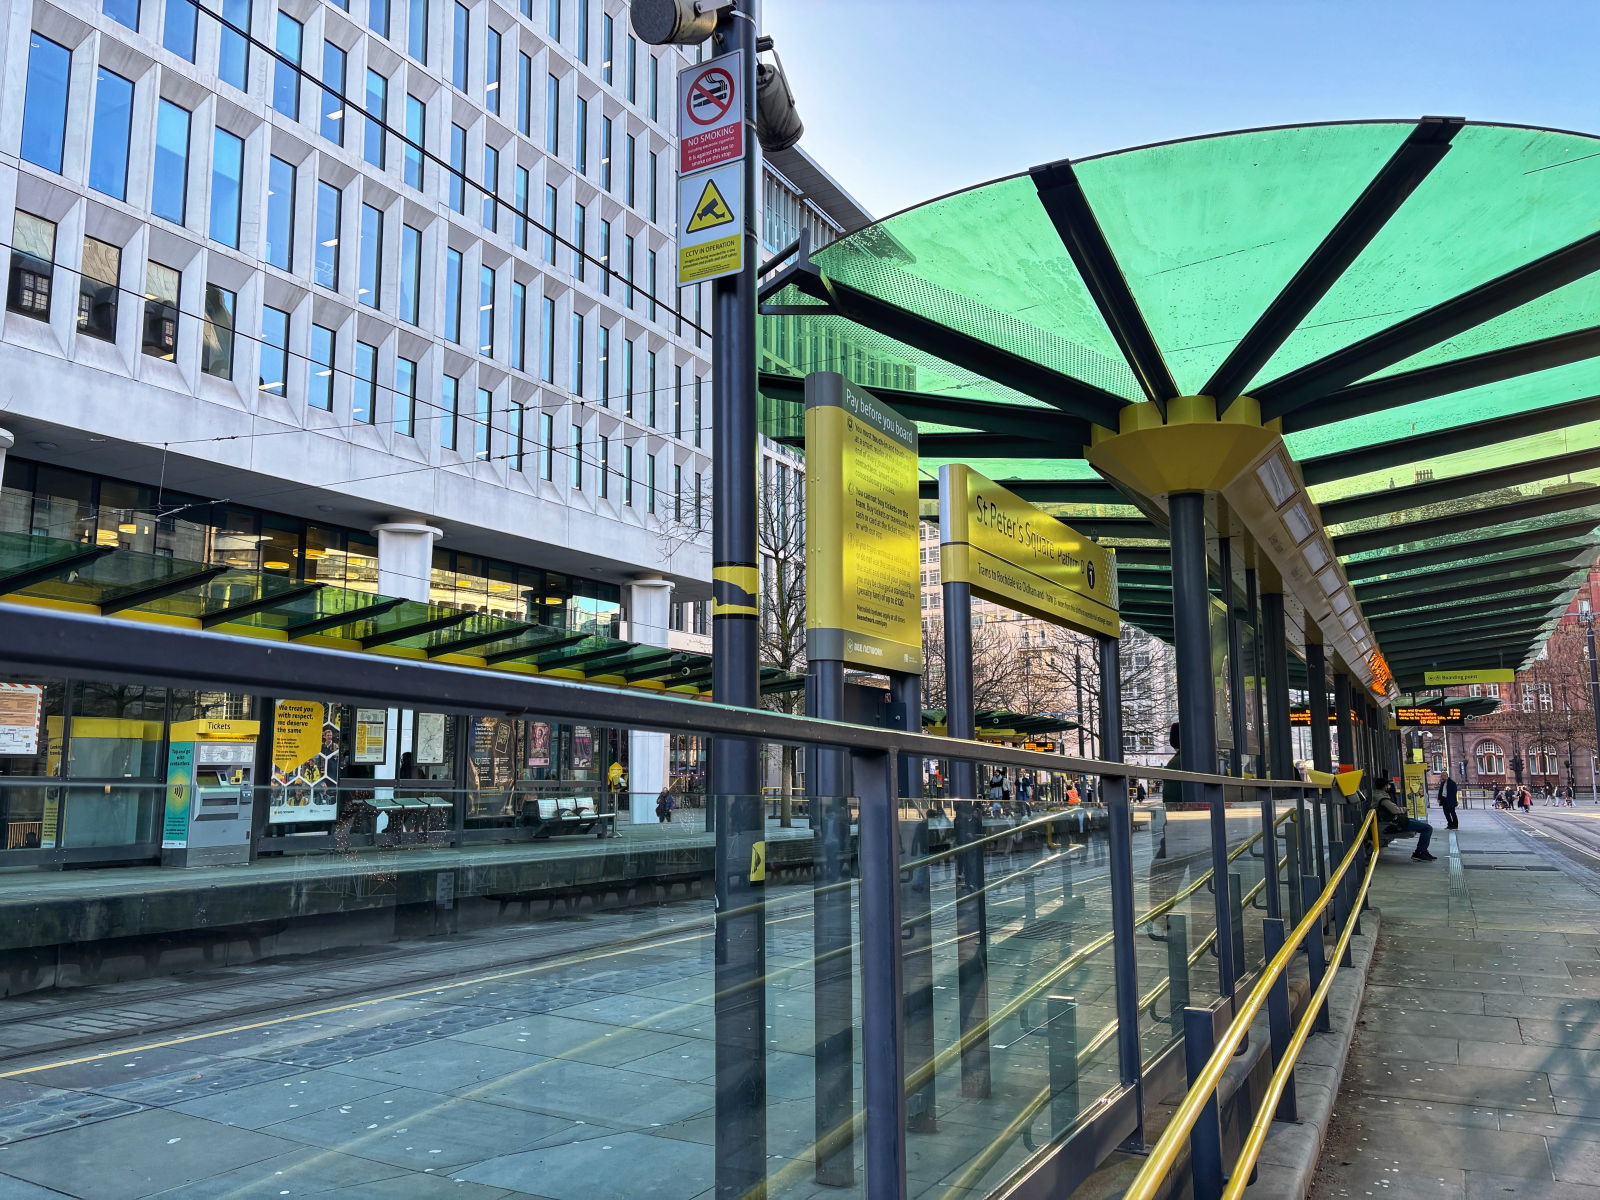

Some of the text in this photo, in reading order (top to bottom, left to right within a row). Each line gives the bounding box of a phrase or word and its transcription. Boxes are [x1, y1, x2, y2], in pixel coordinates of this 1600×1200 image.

[688, 126, 734, 146] NO SMOKING
[697, 150, 712, 159] against
[686, 249, 699, 258] CCTV
[706, 240, 734, 252] OPERATION
[846, 389, 912, 444] Pay before you board
[885, 500, 897, 514] tickets
[976, 494, 1084, 574] St Peter's Square Platform D
[977, 562, 991, 578] Trams
[991, 568, 996, 580] to
[997, 570, 1015, 588] Rochdale
[1022, 581, 1037, 597] Oldham
[1089, 570, 1093, 586] 1
[854, 642, 883, 657] BEE NETWORK
[208, 722, 230, 730] Tickets
